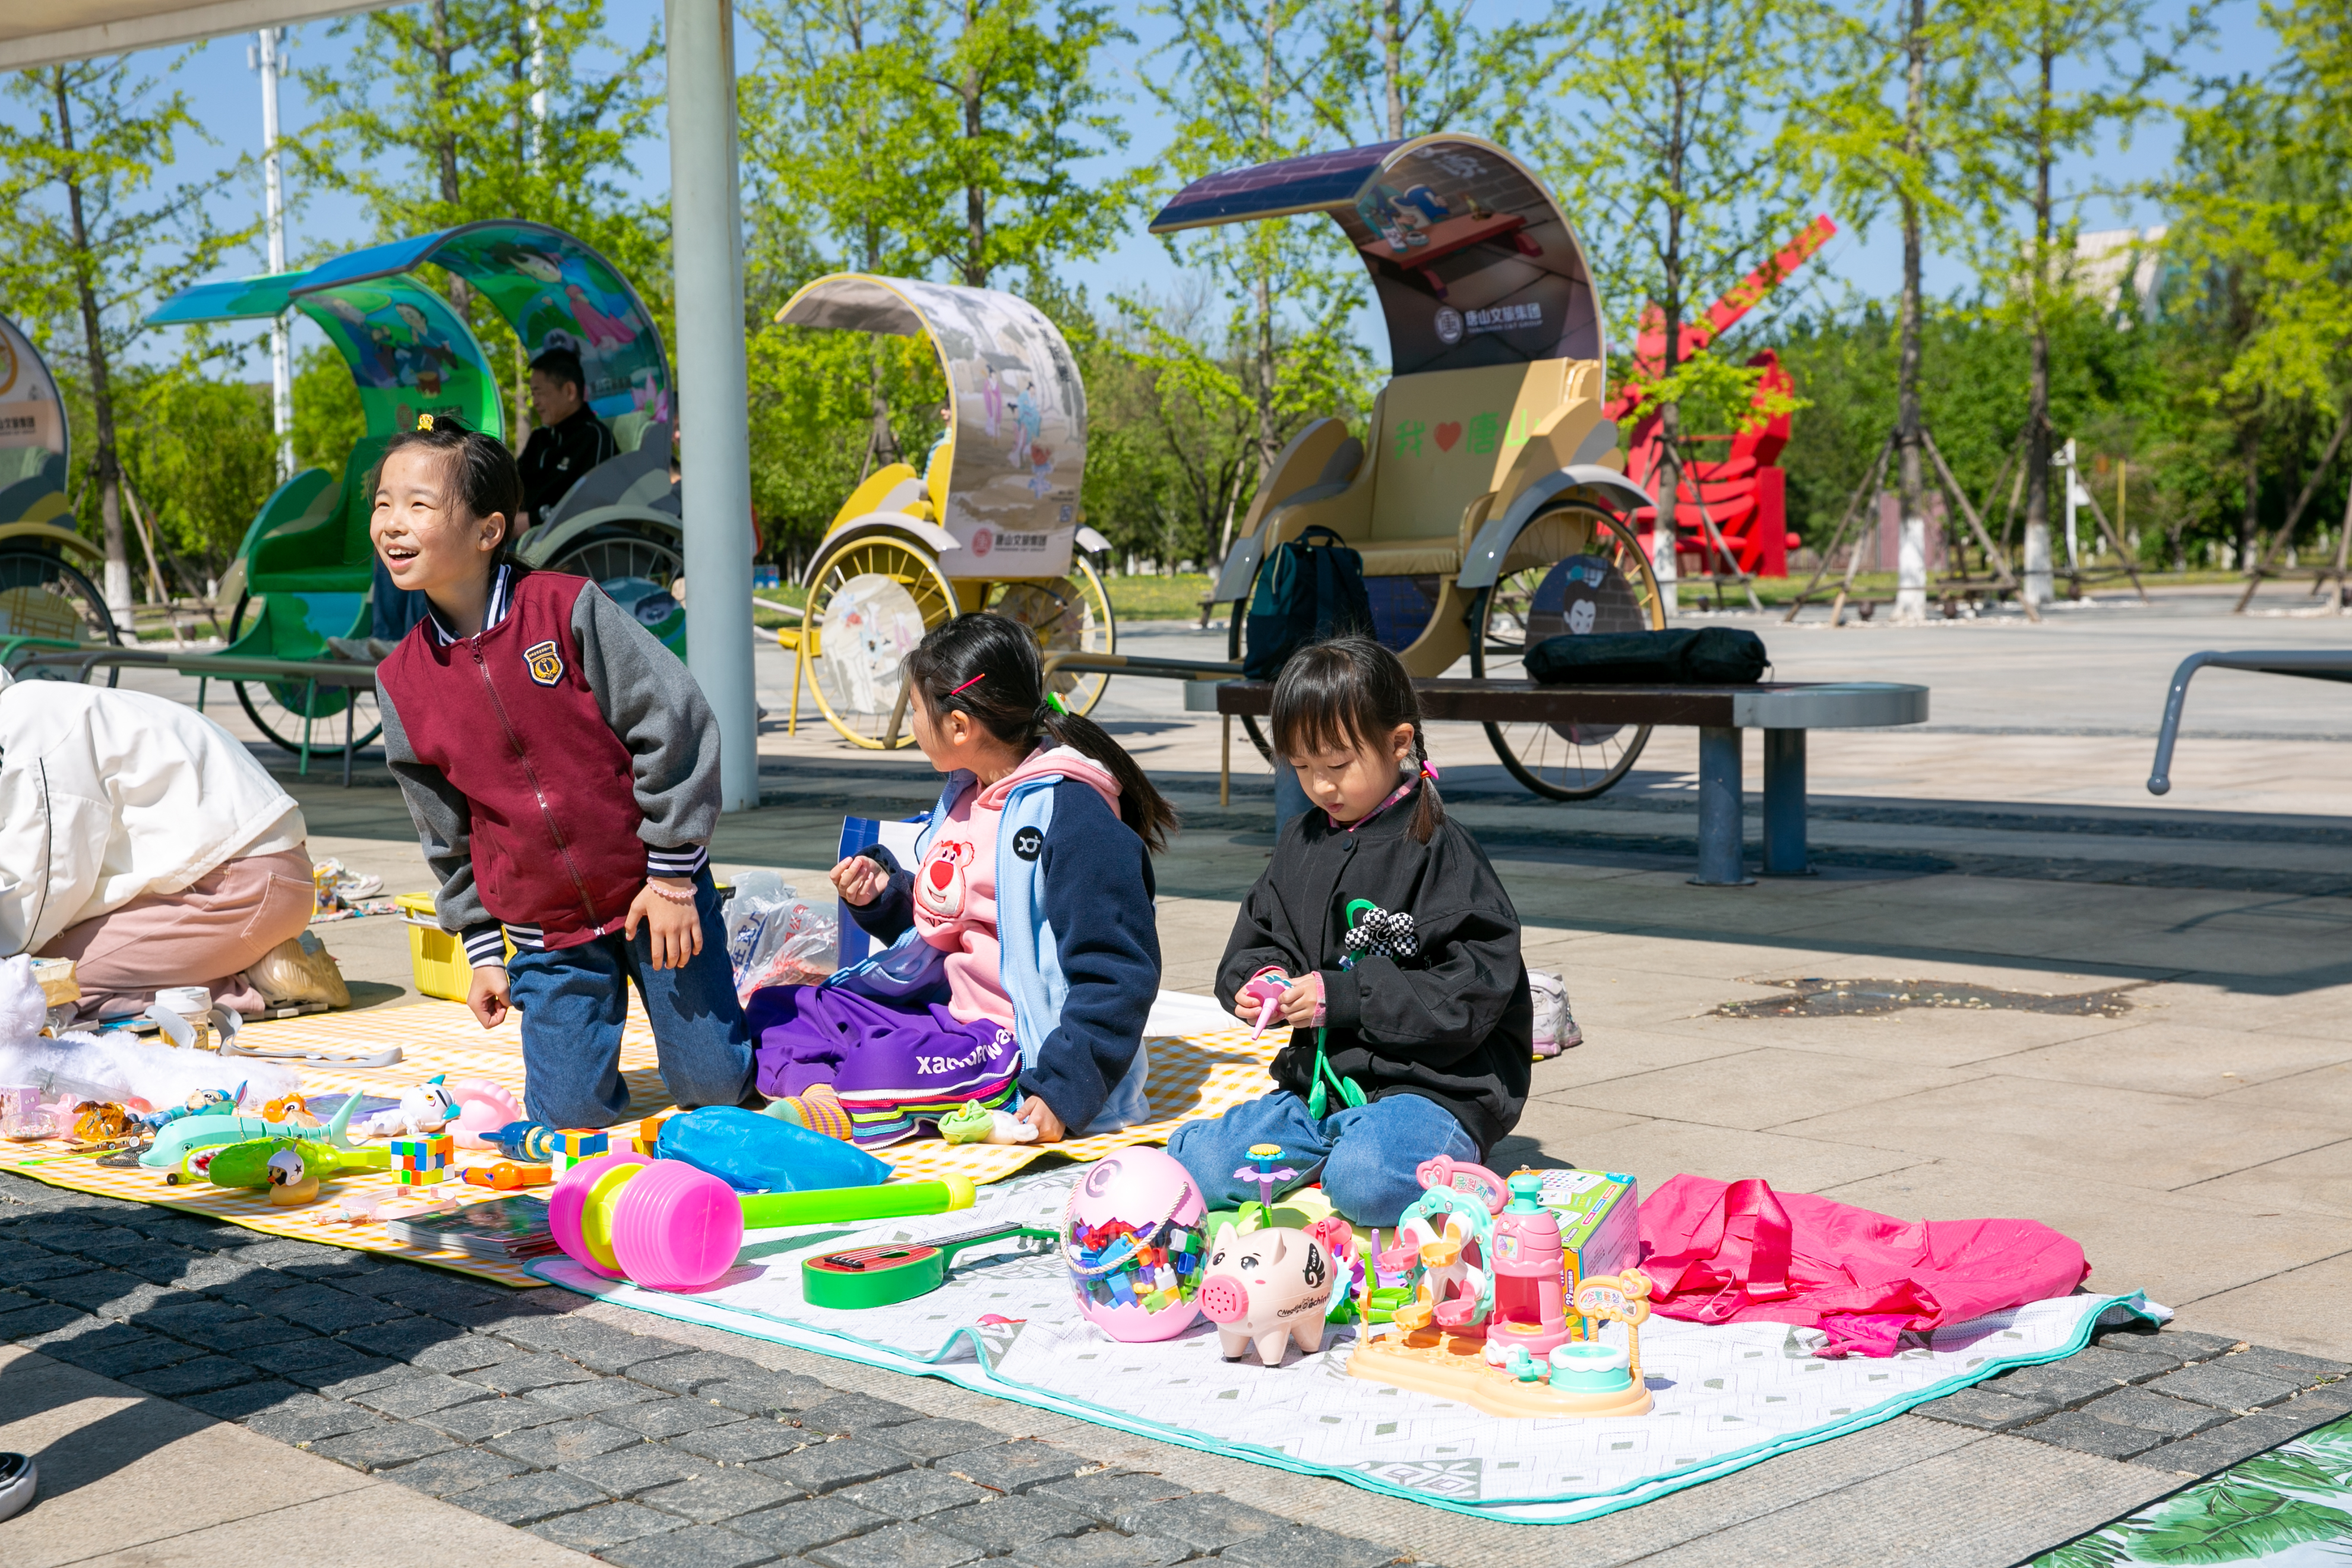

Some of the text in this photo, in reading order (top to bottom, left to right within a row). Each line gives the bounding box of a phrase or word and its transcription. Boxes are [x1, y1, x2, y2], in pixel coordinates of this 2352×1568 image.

[1465, 302, 1542, 327] 唐山文旅集团
[1394, 419, 1425, 460] 我
[1455, 1174, 1488, 1200] 유원지
